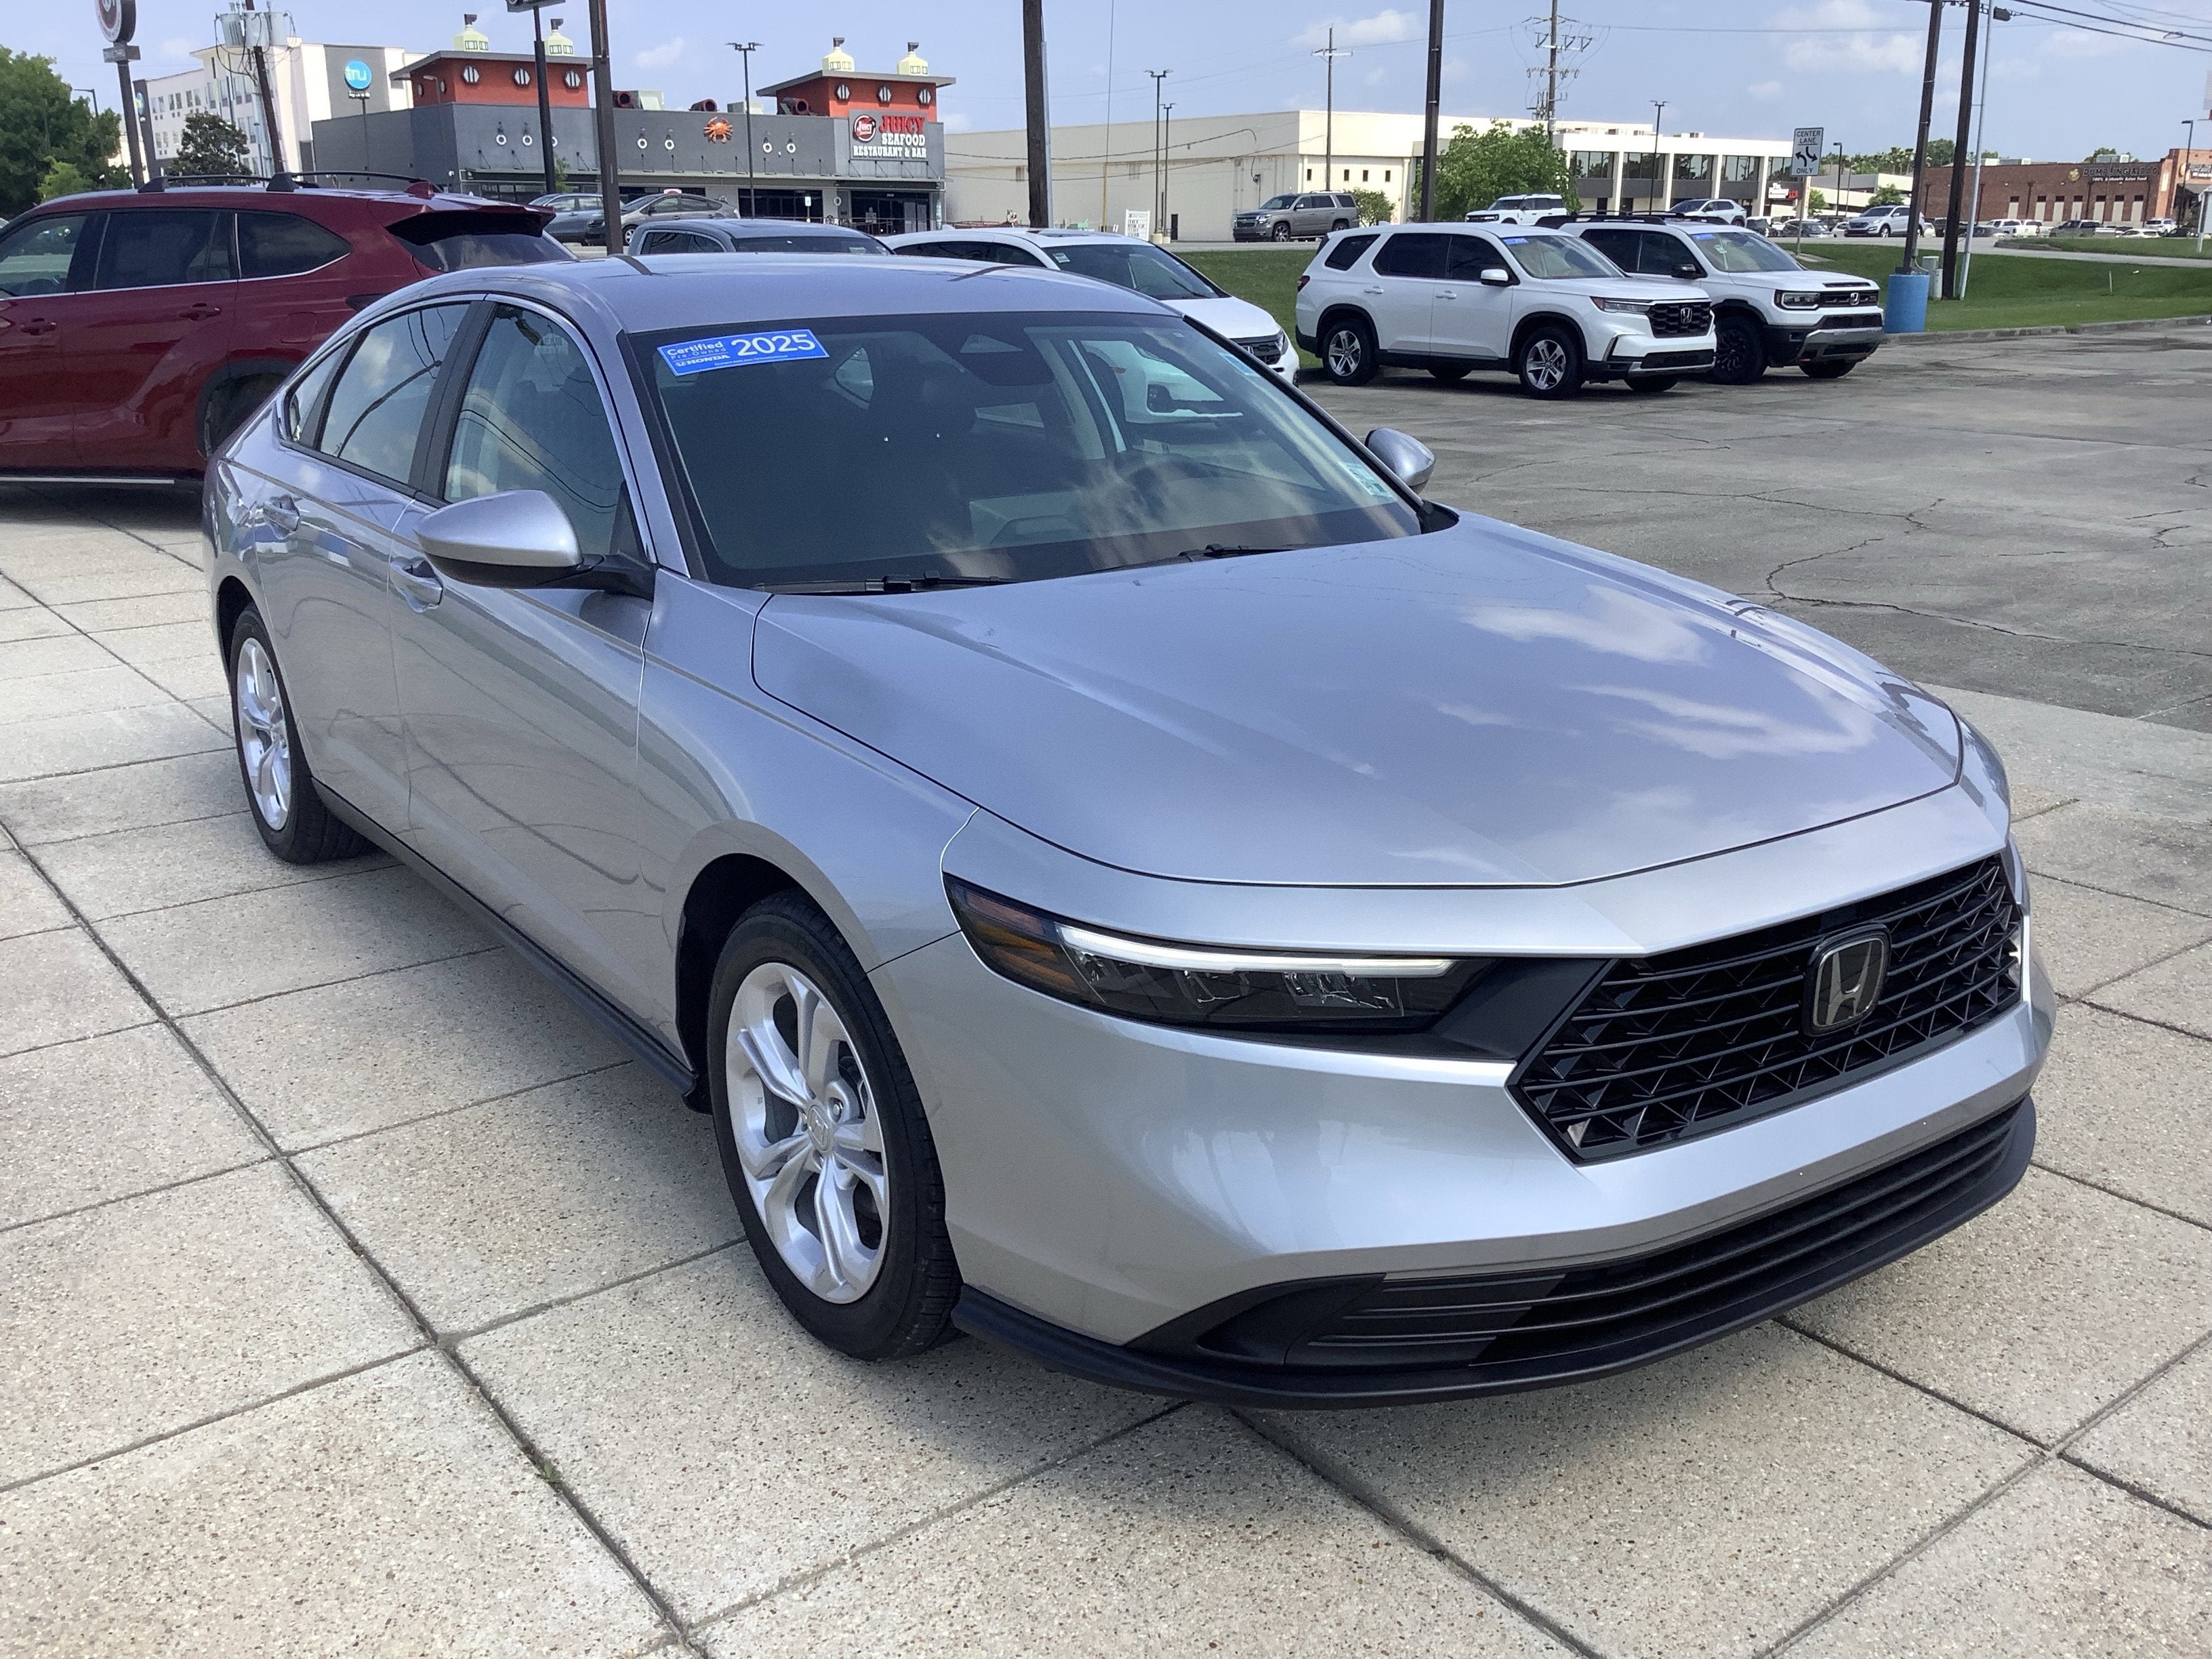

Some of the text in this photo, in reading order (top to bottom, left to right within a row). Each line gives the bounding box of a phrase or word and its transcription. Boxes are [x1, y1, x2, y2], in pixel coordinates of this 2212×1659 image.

[345, 66, 367, 81] tru
[879, 115, 925, 134] JUICY
[882, 133, 926, 146] SEAFOOD
[853, 146, 927, 158] RESTAURANT & BAR
[2083, 167, 2129, 176] DUMPING
[667, 341, 724, 356] Certified
[731, 334, 816, 356] 2025
[686, 354, 731, 365] HONDA
